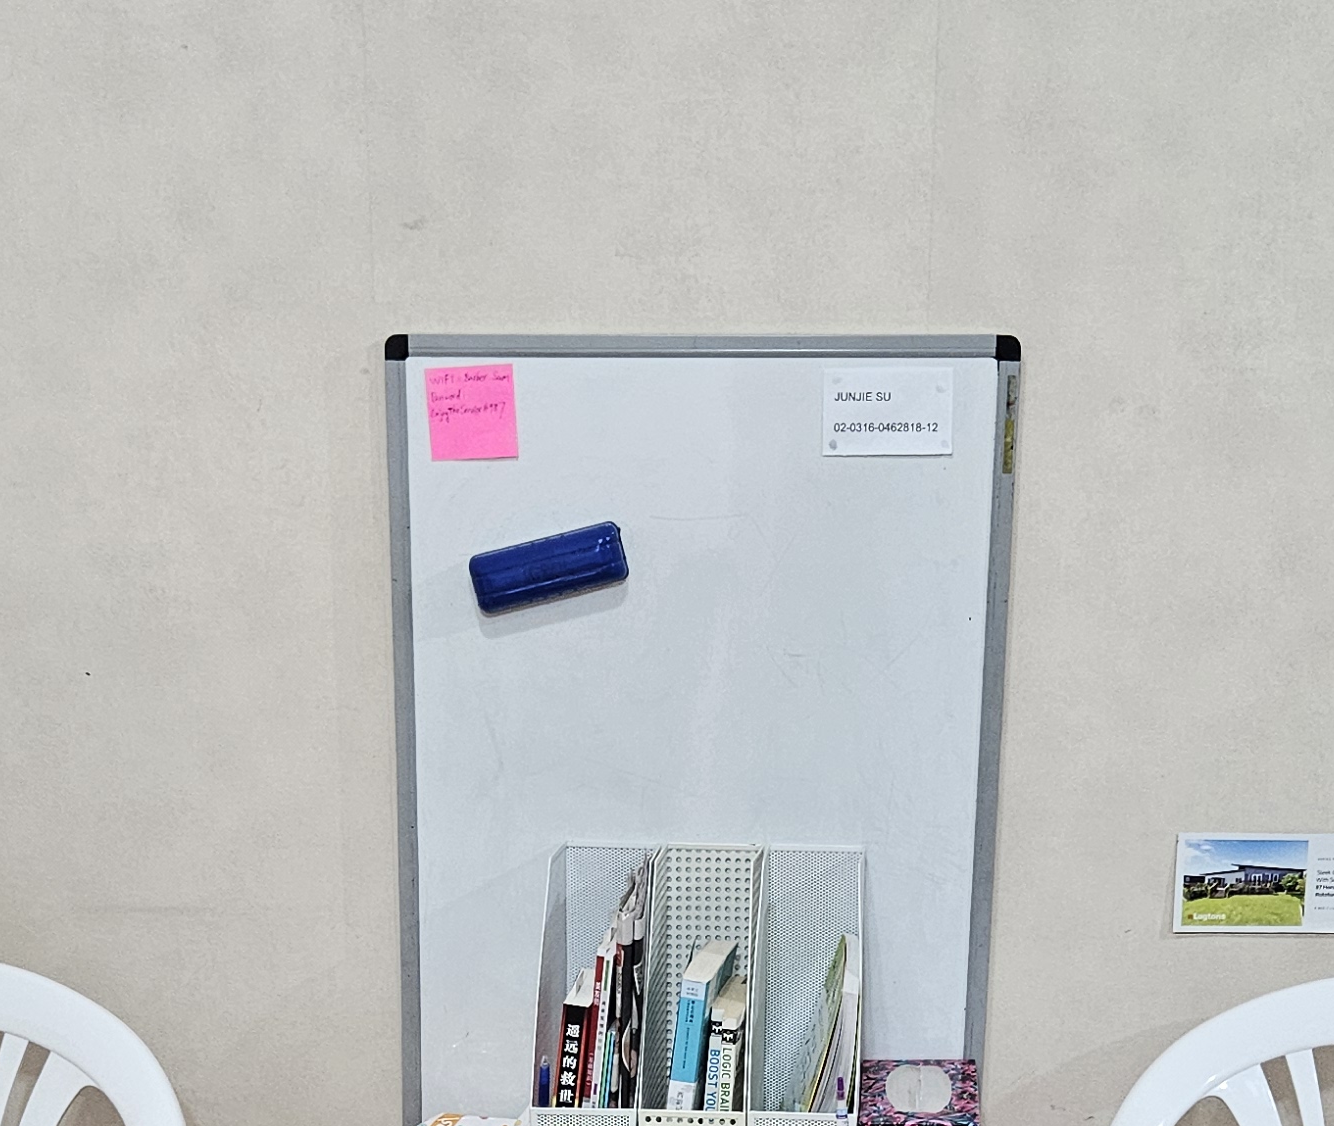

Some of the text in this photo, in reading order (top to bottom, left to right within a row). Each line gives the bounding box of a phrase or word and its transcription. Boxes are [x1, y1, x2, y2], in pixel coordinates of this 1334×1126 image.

[834, 391, 892, 402] JUNJIE SU
[833, 422, 939, 433] 02-0316-0462818-12
[1192, 912, 1227, 922] Lugtons
[708, 1048, 721, 1089] BOOST
[721, 1047, 733, 1080] LOGIC
